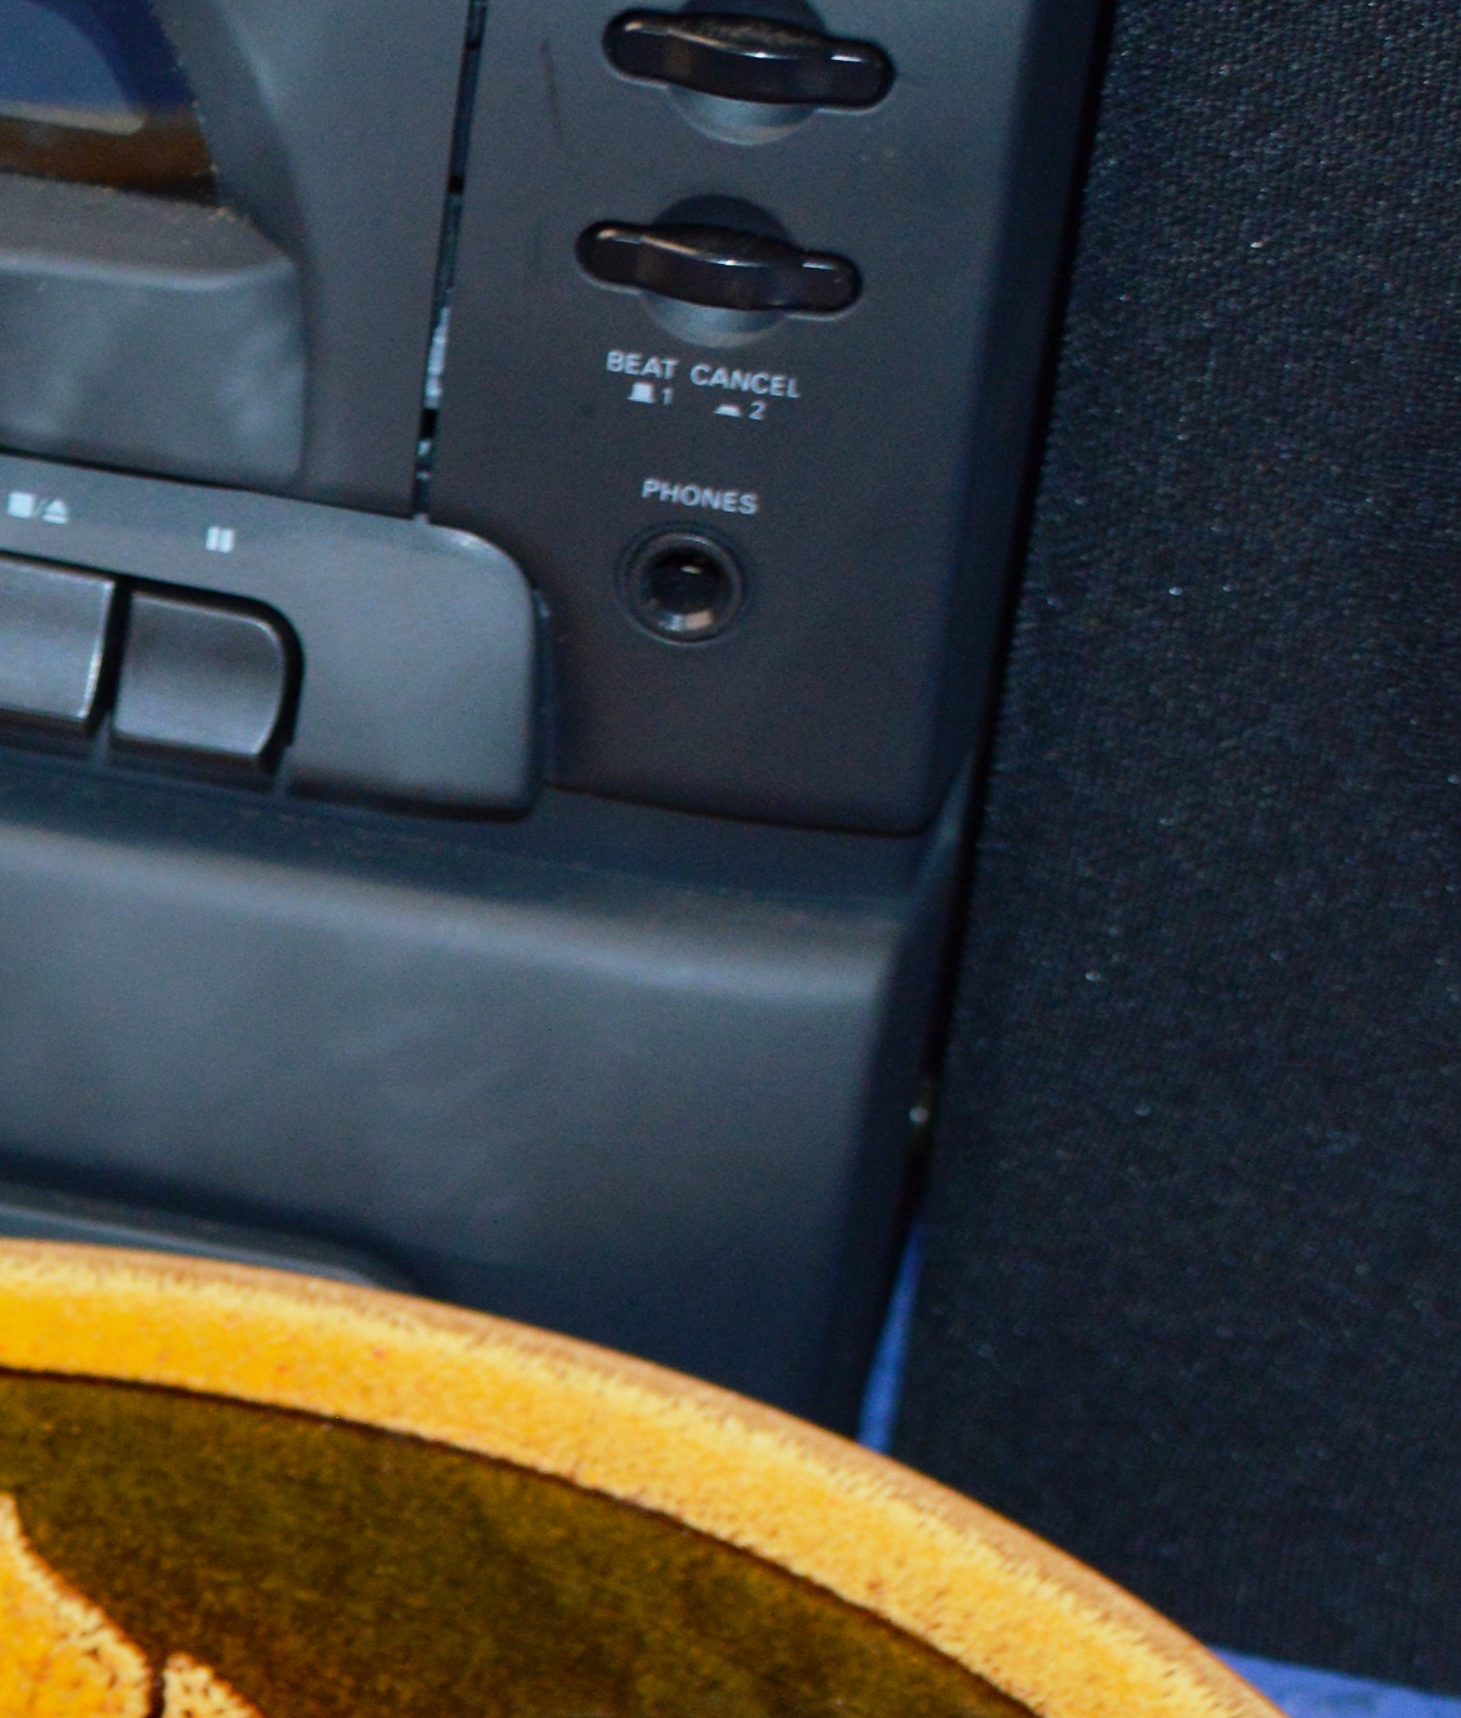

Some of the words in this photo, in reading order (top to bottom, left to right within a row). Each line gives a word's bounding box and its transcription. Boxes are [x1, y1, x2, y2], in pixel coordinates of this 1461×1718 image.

[606, 350, 679, 380] BEAT
[690, 363, 802, 399] CANCEL
[661, 386, 674, 405] 1
[748, 400, 768, 421] 2
[641, 477, 759, 516] PHONES
